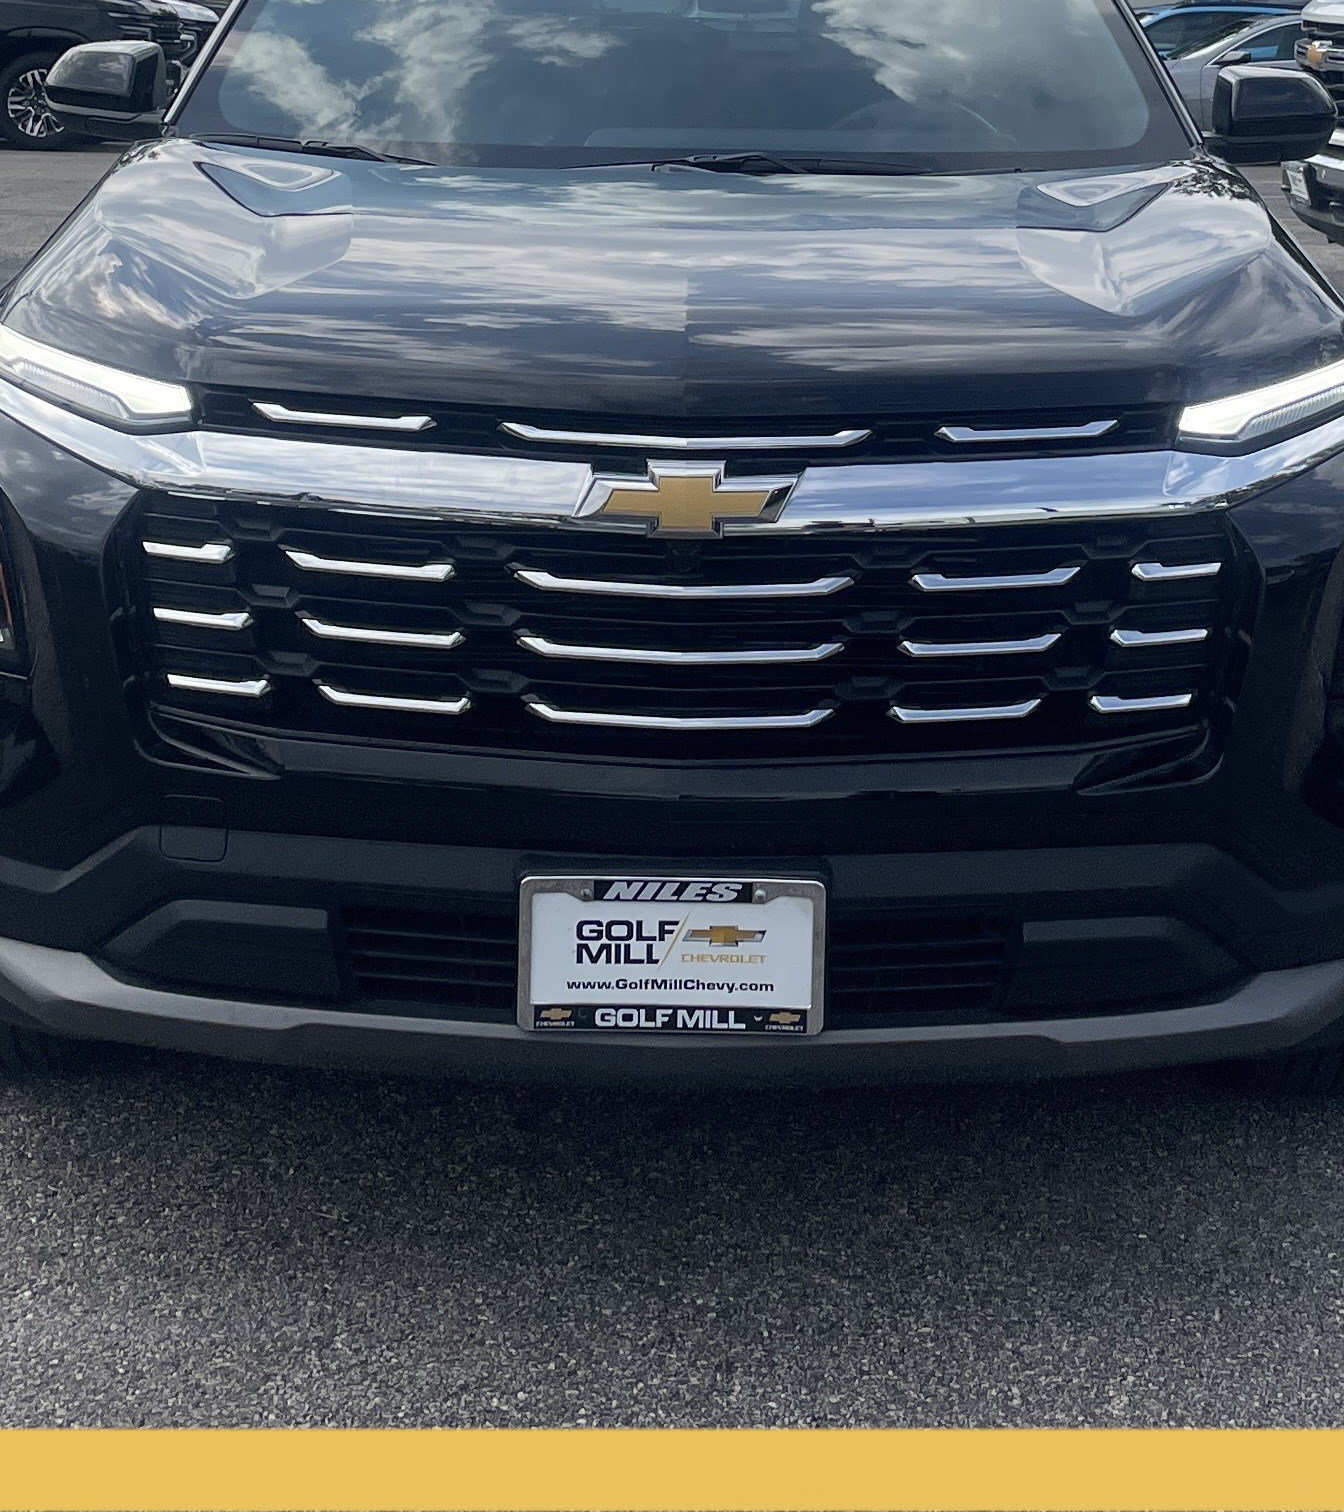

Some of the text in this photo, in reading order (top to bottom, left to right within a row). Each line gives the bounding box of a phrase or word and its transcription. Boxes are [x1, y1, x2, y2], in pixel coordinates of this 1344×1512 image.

[602, 881, 743, 902] NILES
[575, 919, 681, 942] GOLF
[575, 943, 661, 965] MILL
[680, 953, 767, 964] CHEVROLET
[566, 978, 775, 993] www.GolfMillChevy.com
[594, 1008, 746, 1030] GOLF MILL
